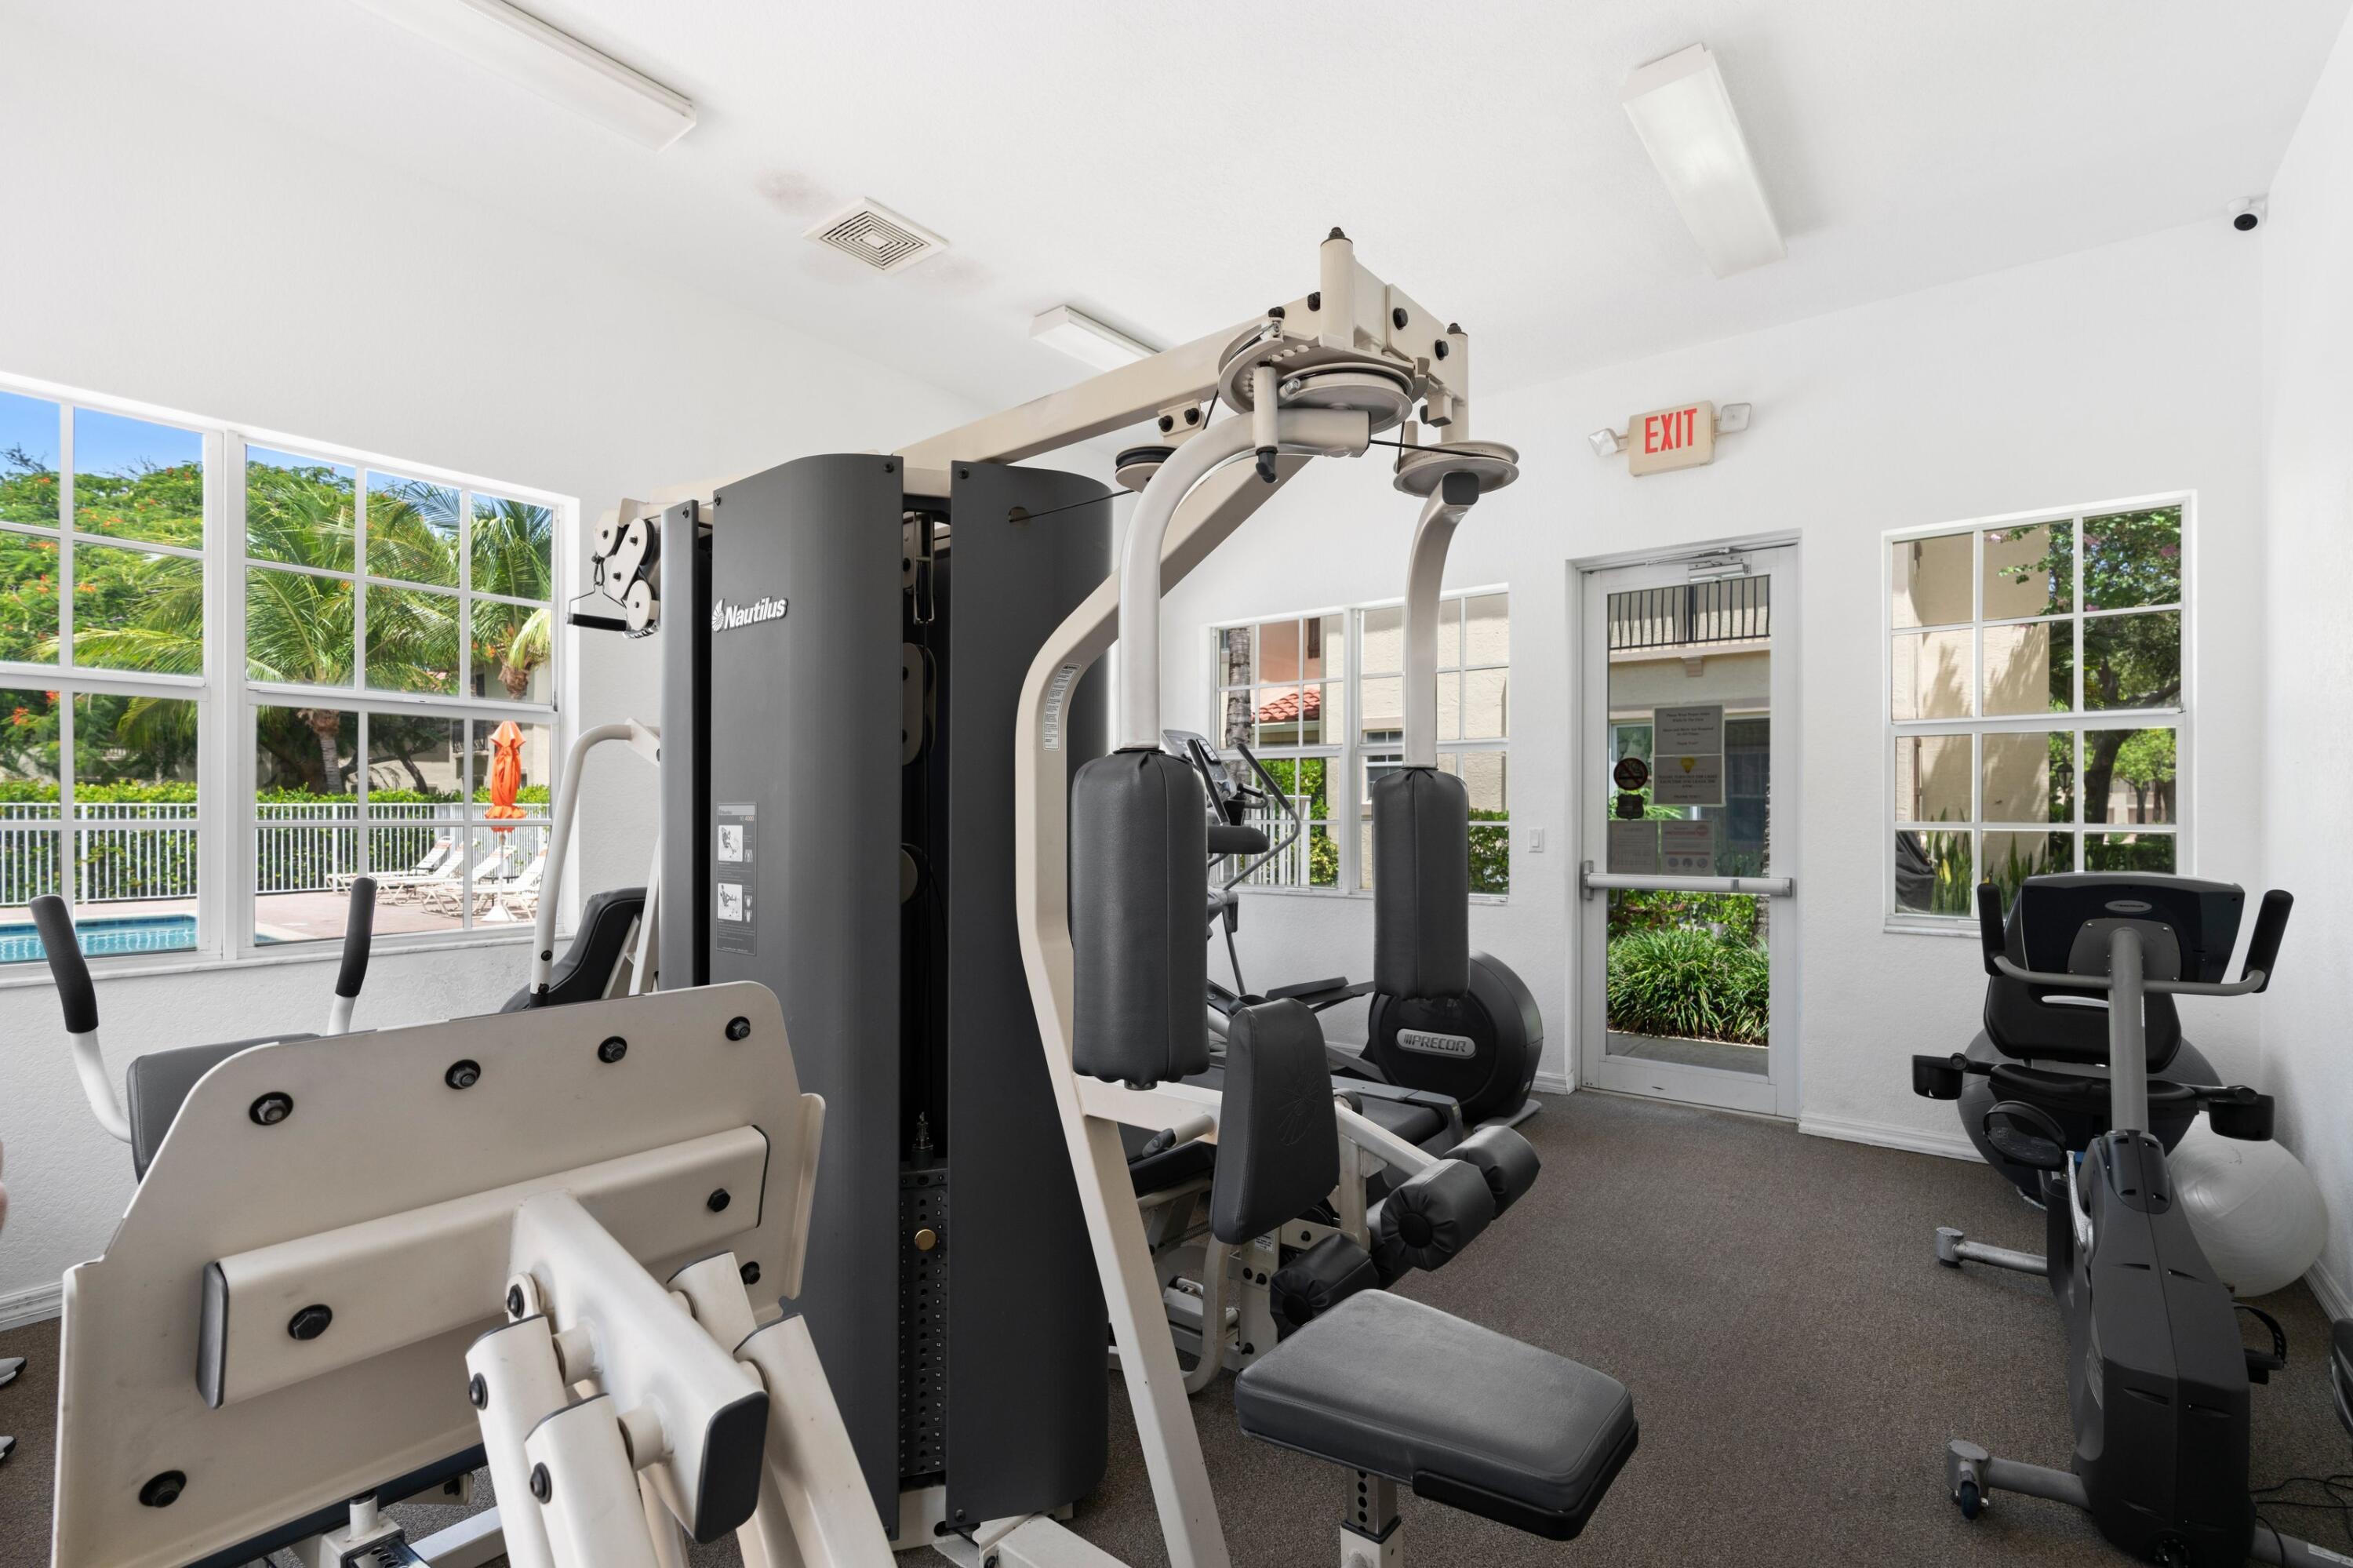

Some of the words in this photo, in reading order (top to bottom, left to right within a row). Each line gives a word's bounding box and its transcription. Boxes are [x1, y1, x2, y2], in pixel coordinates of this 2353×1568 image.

[1644, 408, 1697, 454] EXIT
[724, 597, 787, 630] Nautilus
[1411, 1035, 1467, 1053] PRECOR
